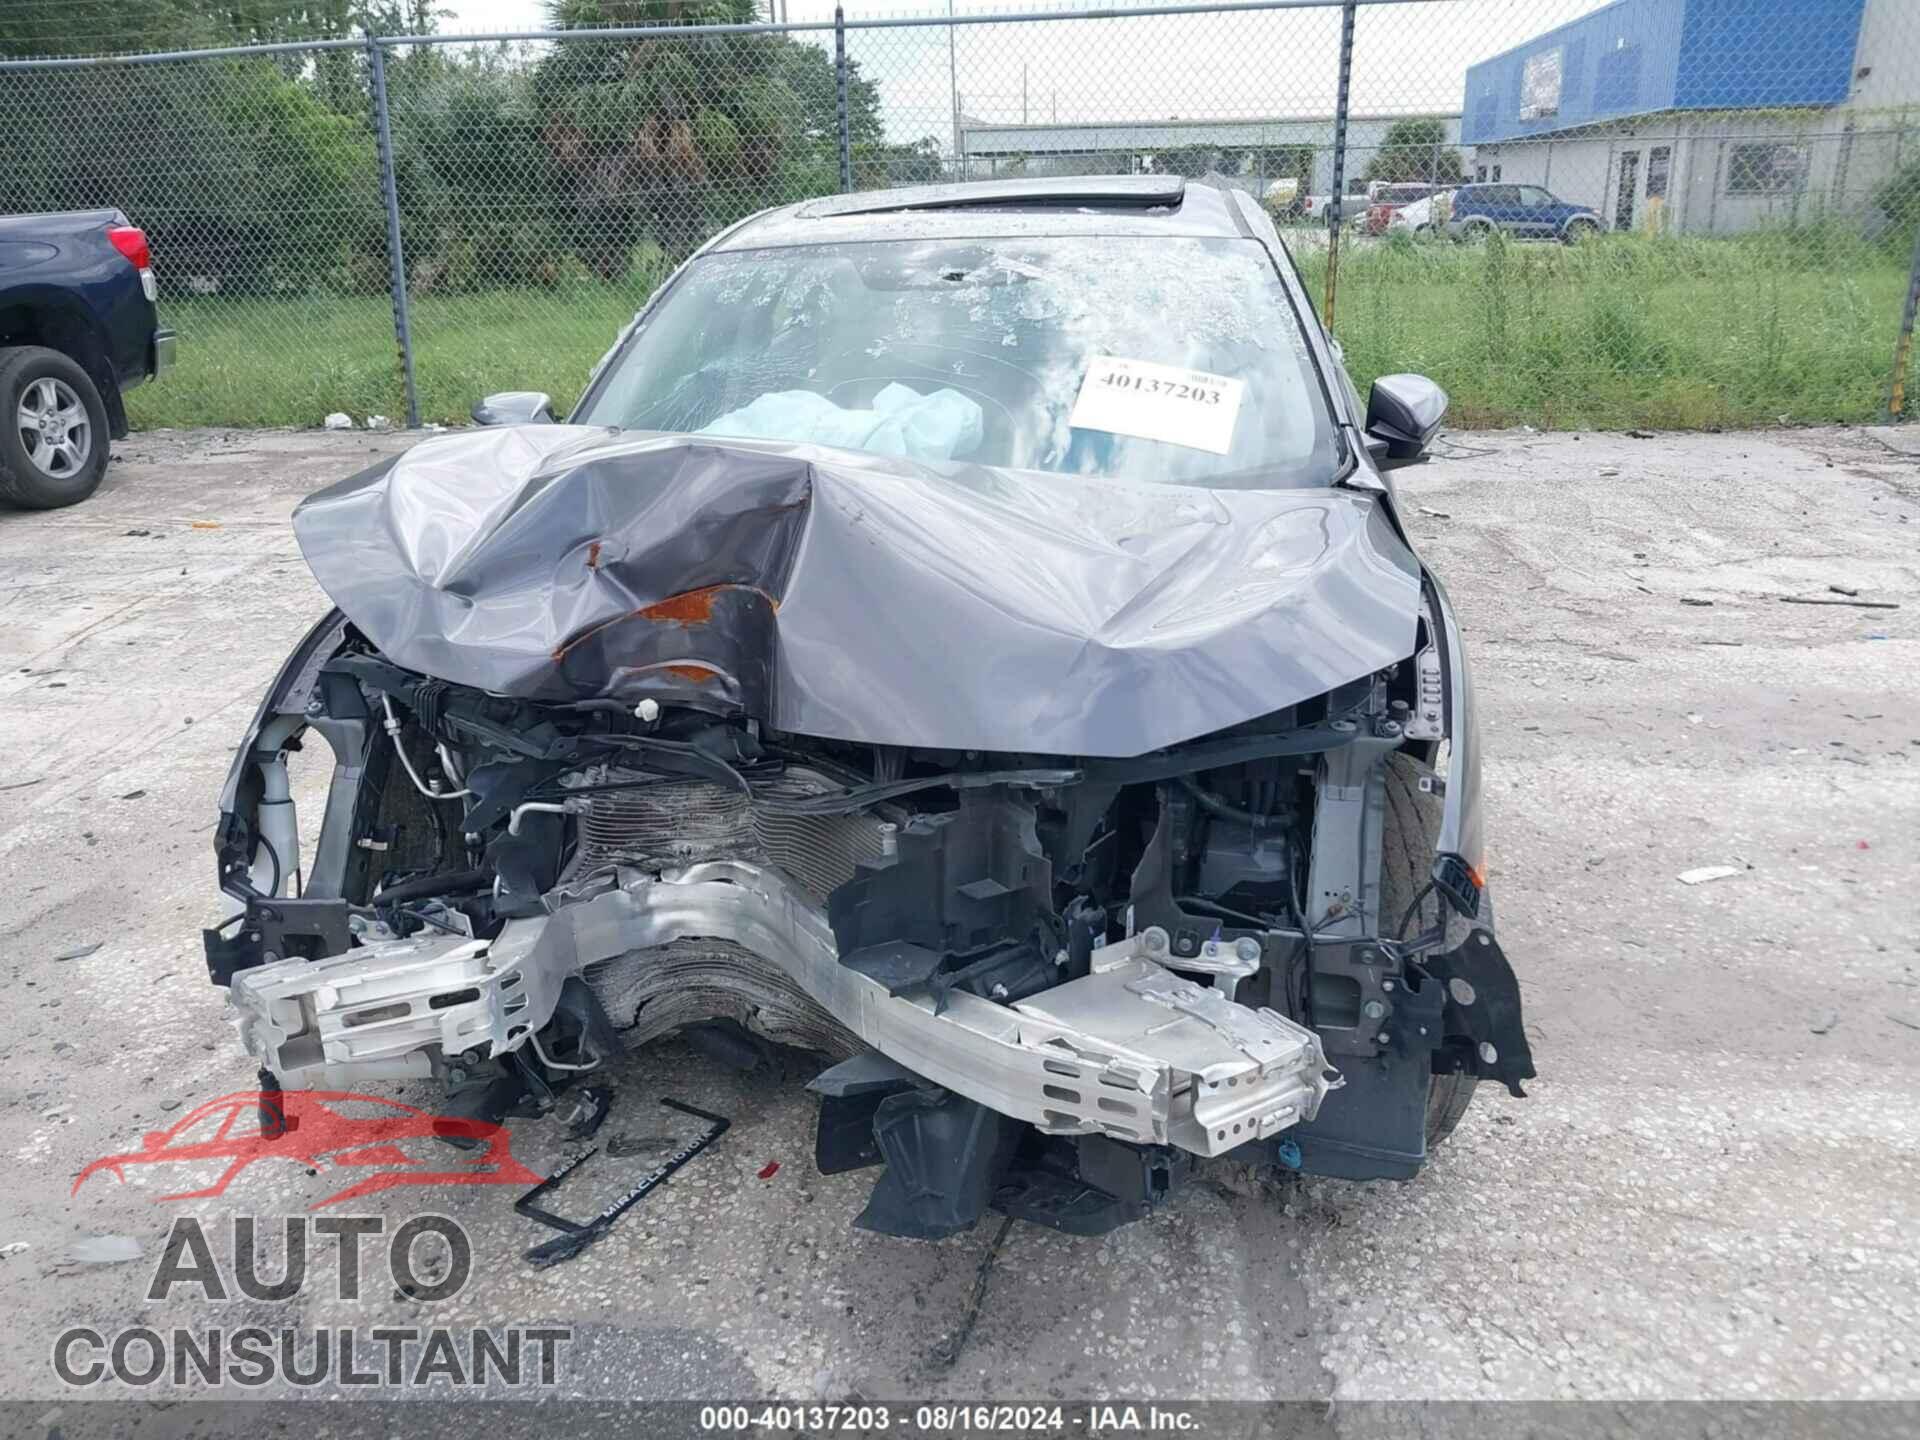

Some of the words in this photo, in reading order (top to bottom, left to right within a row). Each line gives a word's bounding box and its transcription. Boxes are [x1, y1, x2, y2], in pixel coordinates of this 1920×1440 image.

[1100, 372, 1222, 405] 40137203
[602, 1167, 667, 1217] MIRACLE
[669, 1132, 714, 1163] TOYOTA
